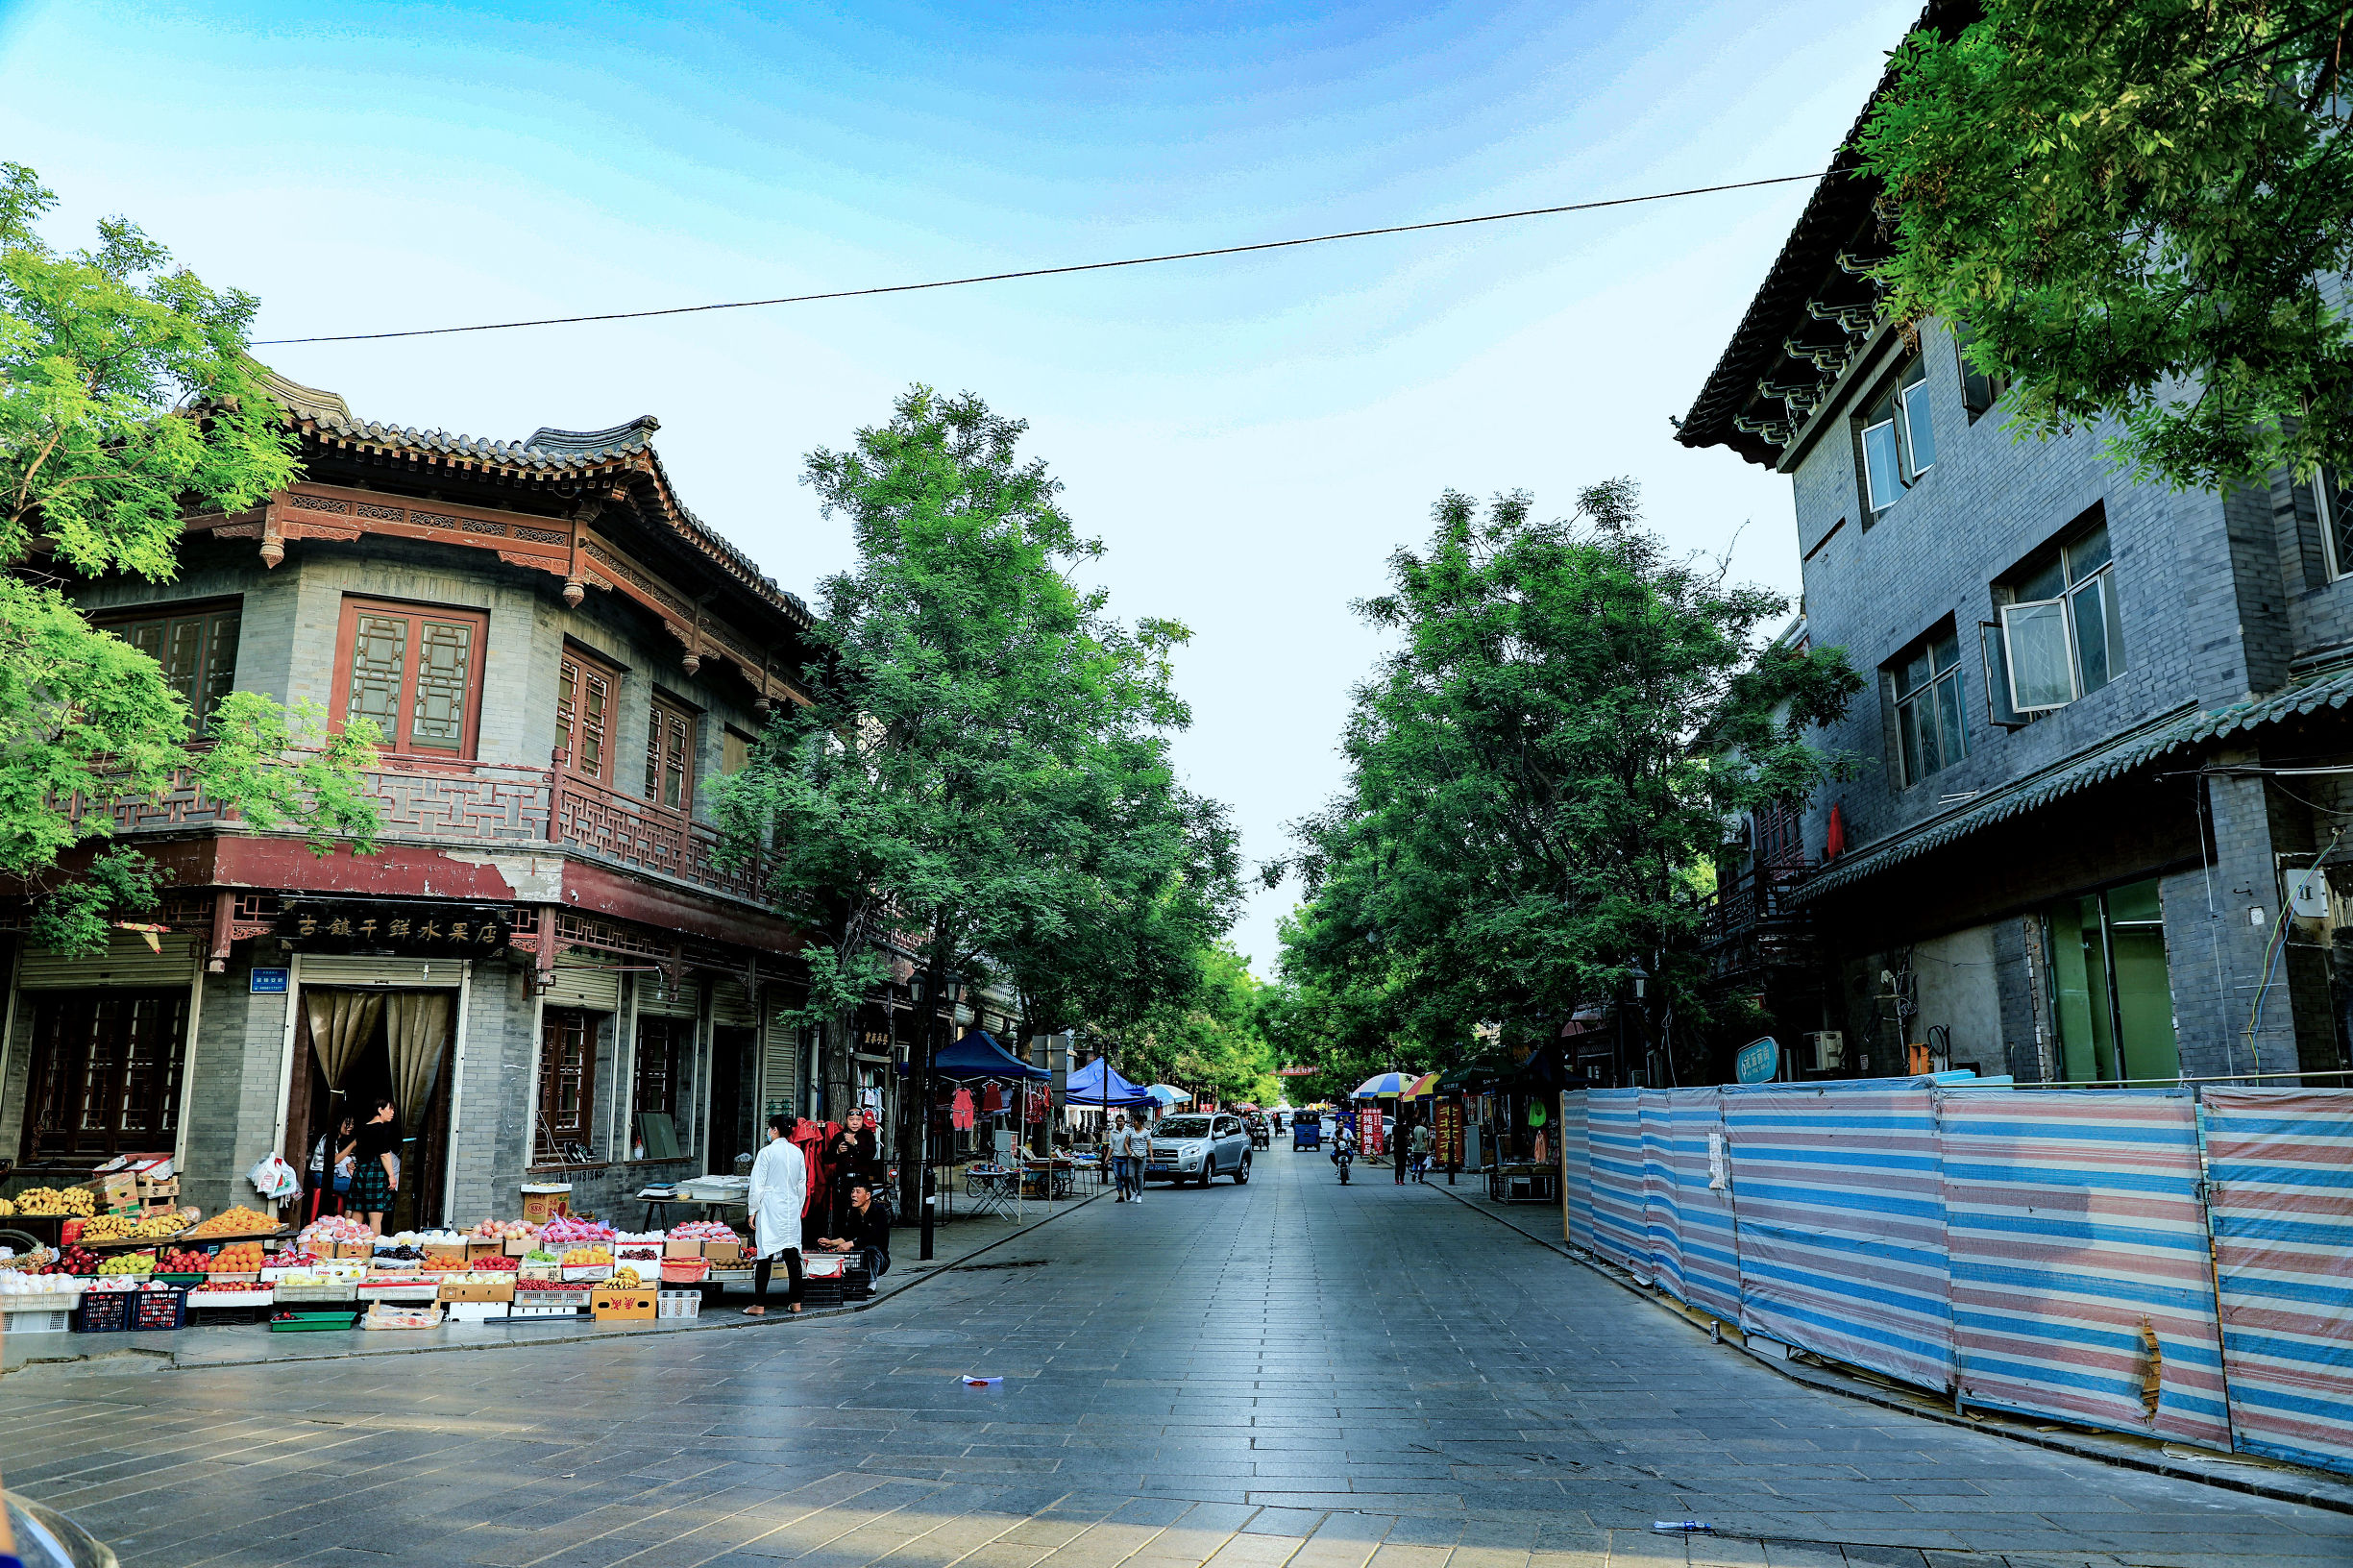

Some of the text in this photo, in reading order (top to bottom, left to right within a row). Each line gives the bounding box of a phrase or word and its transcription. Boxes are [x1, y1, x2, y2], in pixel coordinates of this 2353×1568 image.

[298, 915, 497, 943] 古鎮干鲜水果店
[1362, 1115, 1374, 1155] 纯银饰品
